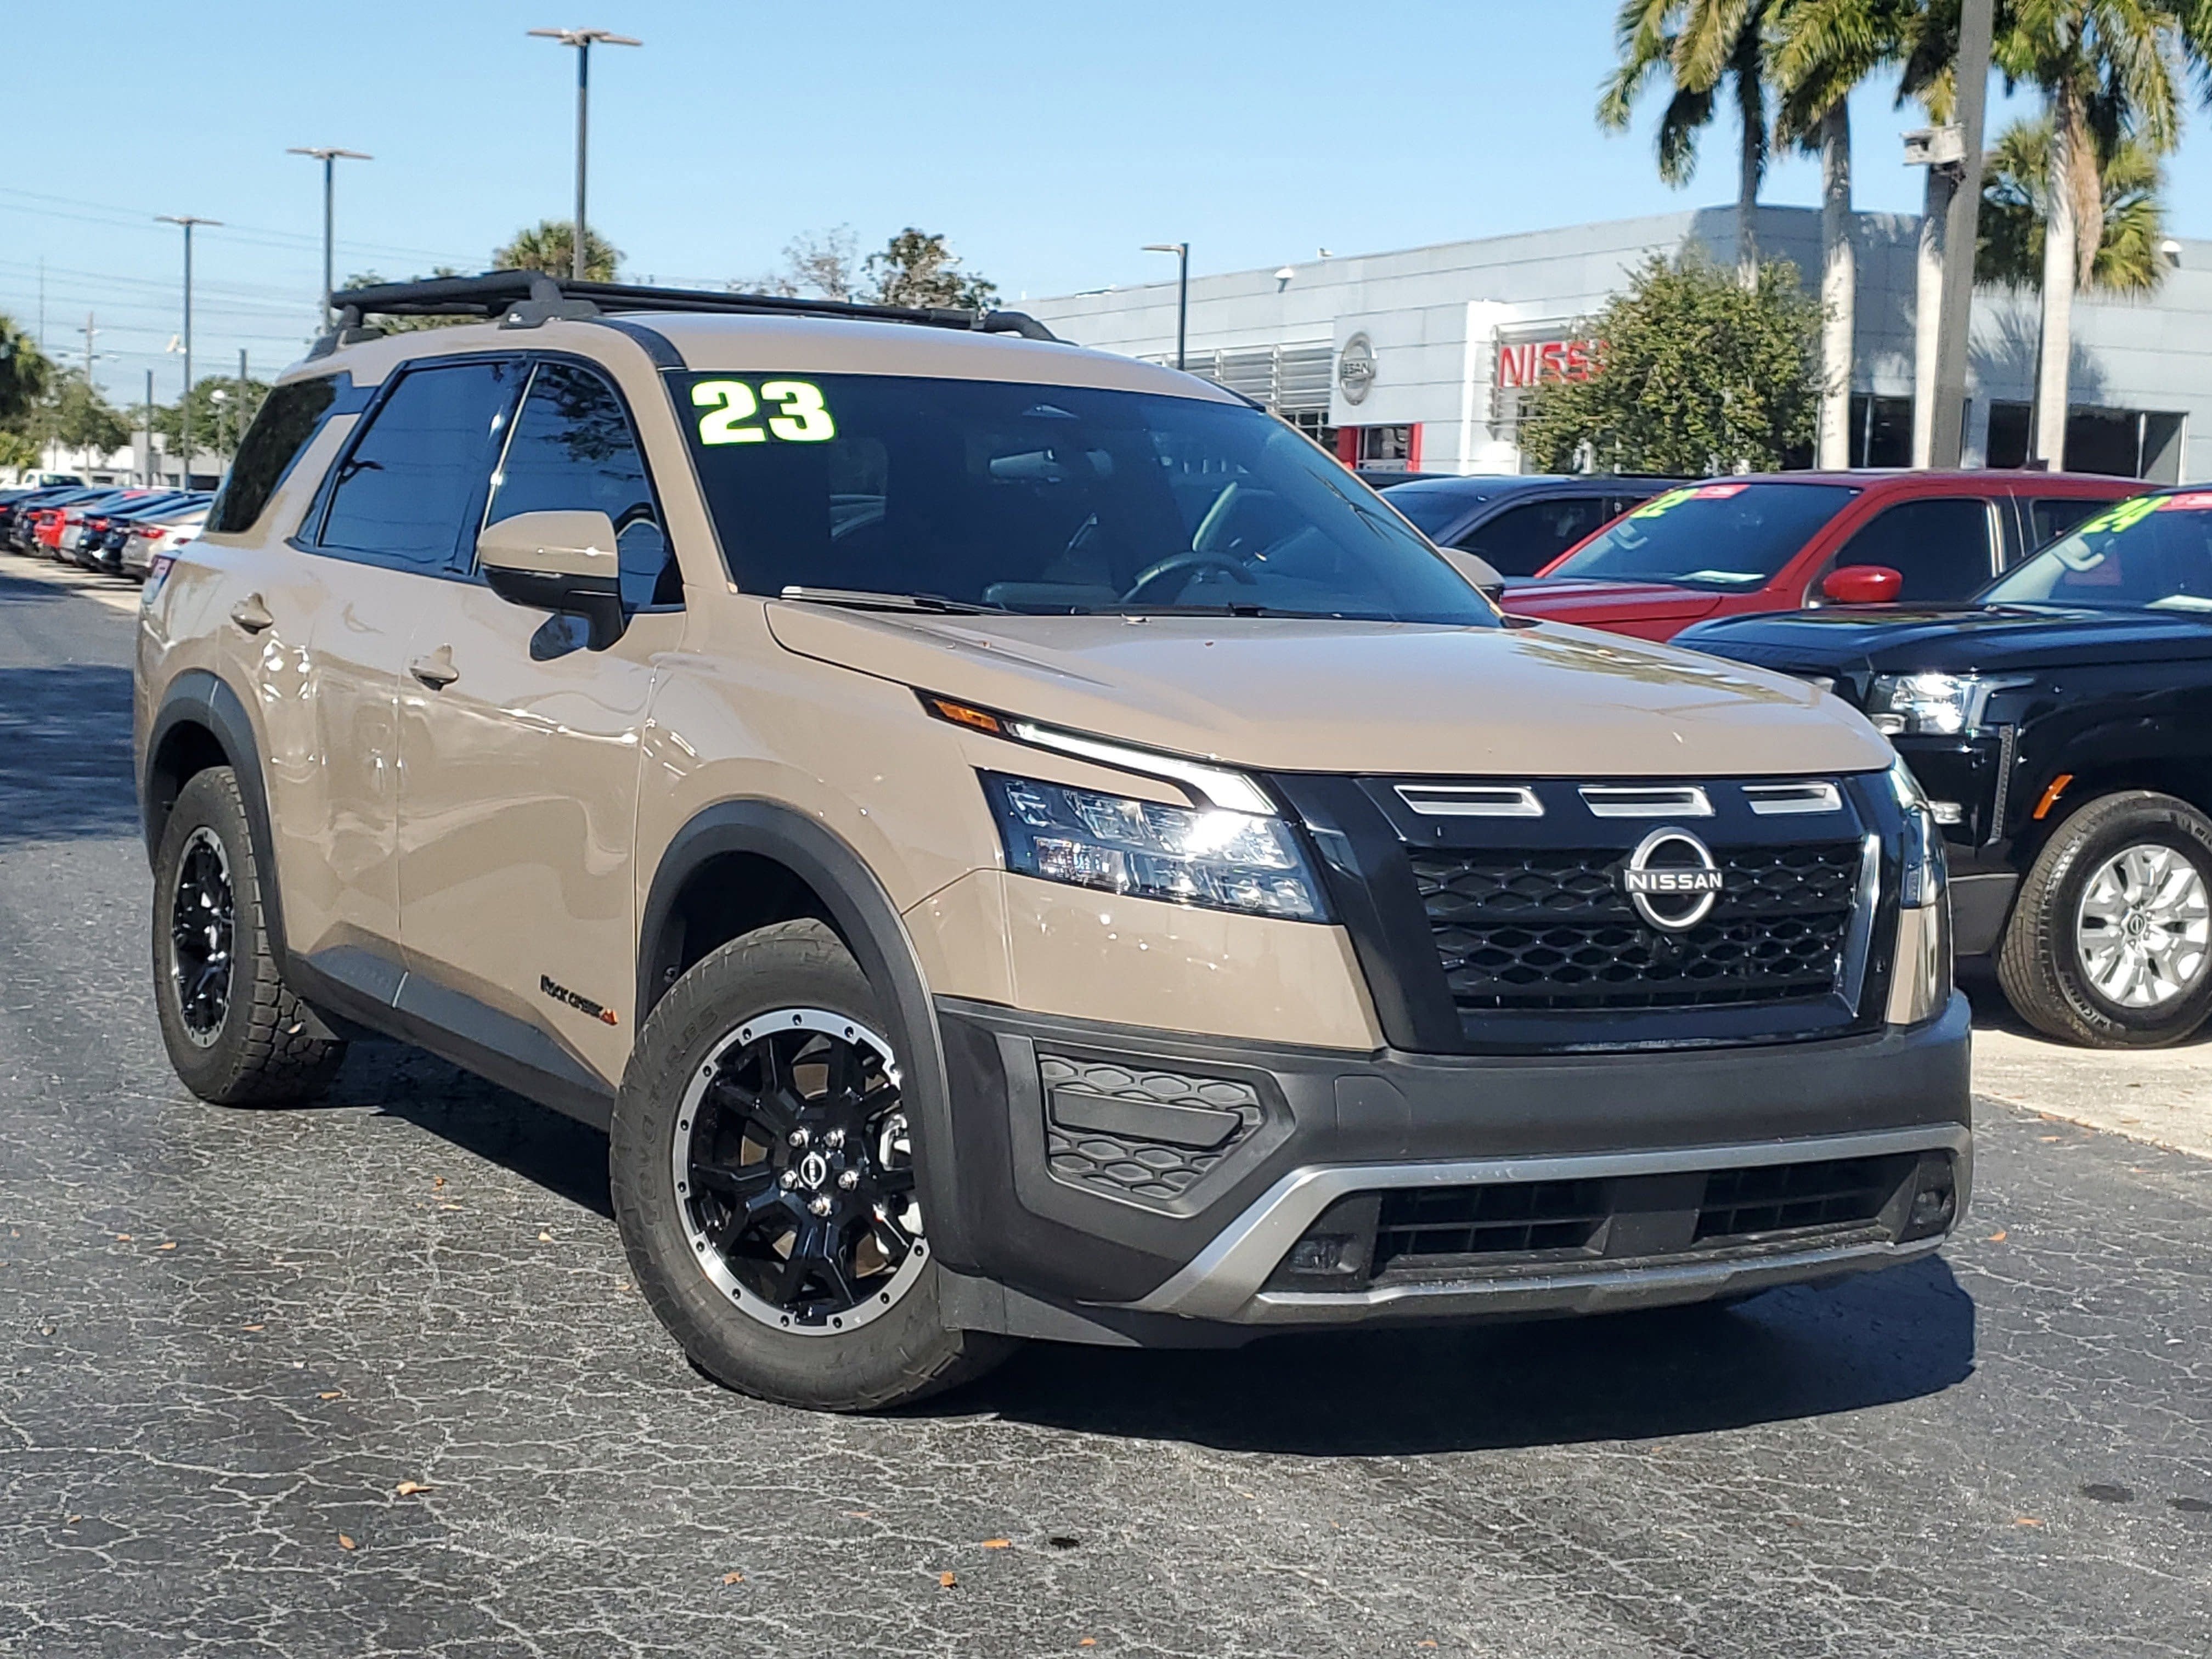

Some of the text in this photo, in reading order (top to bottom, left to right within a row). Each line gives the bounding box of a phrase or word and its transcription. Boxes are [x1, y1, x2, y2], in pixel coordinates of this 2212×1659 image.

[1499, 340, 1610, 388] NISS
[691, 379, 837, 446] 23
[1628, 872, 1723, 890] NISSAN
